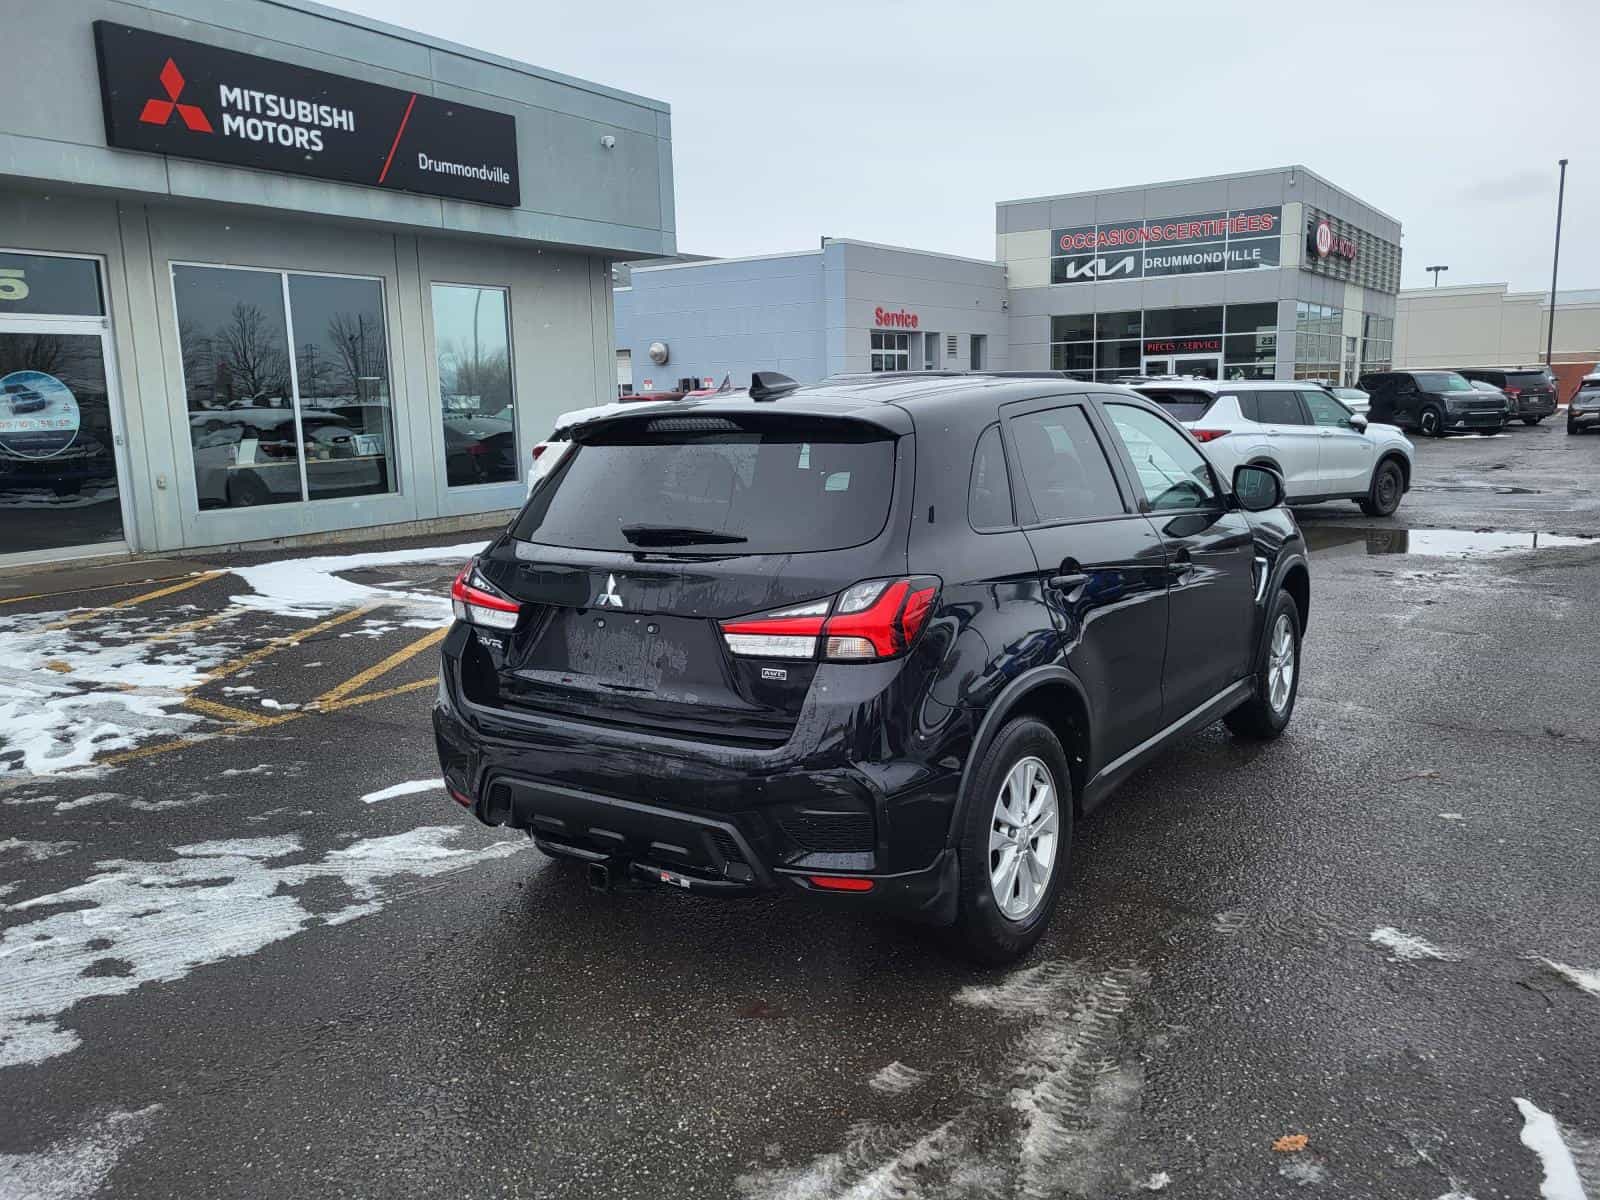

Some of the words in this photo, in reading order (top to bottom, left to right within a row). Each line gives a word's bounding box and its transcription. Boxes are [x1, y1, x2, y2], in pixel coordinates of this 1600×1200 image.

[219, 84, 355, 132] MITSUBISHI
[223, 114, 324, 151] MOTORS
[418, 152, 510, 185] Drummondville
[1144, 248, 1262, 269] DRUMMONDVILLE
[875, 306, 919, 328] Service
[1184, 340, 1220, 351] SERVICE
